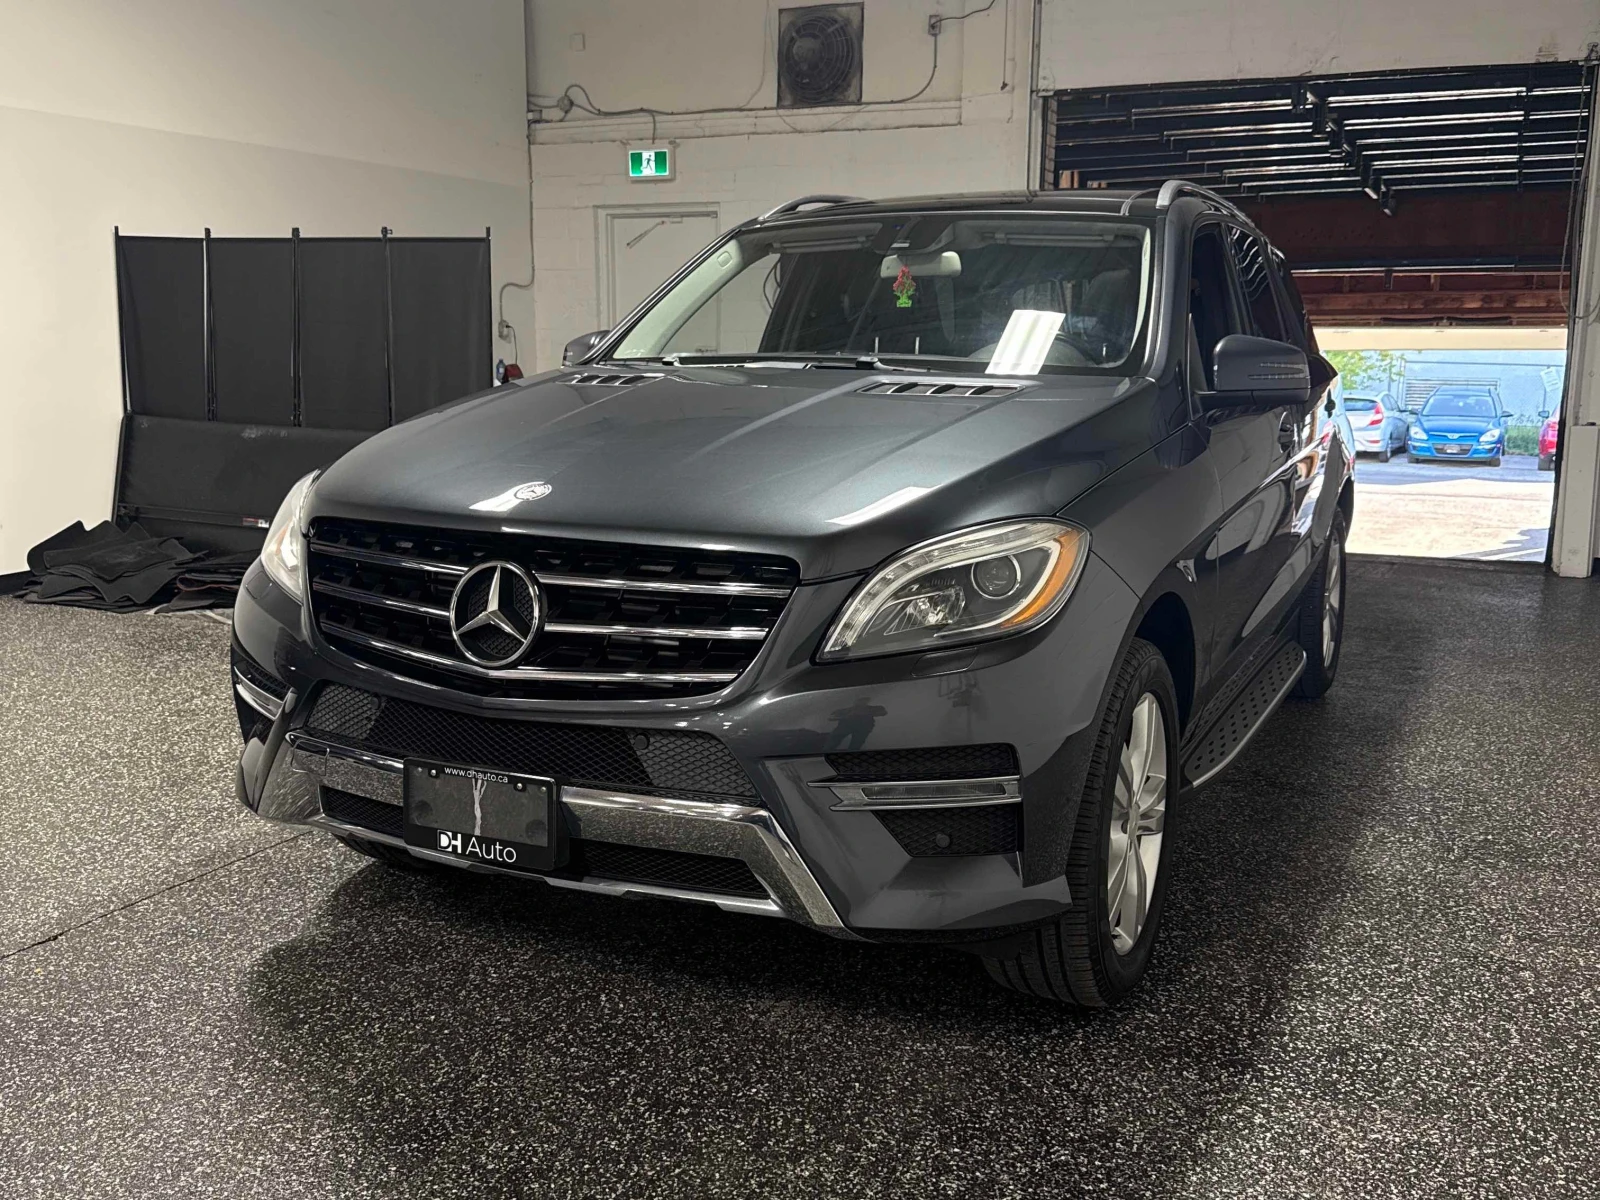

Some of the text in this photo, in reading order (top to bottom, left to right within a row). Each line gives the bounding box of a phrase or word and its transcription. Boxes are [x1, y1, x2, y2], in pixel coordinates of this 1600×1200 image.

[444, 766, 508, 783] www.dhauto.ca
[437, 829, 517, 863] DH Auto
